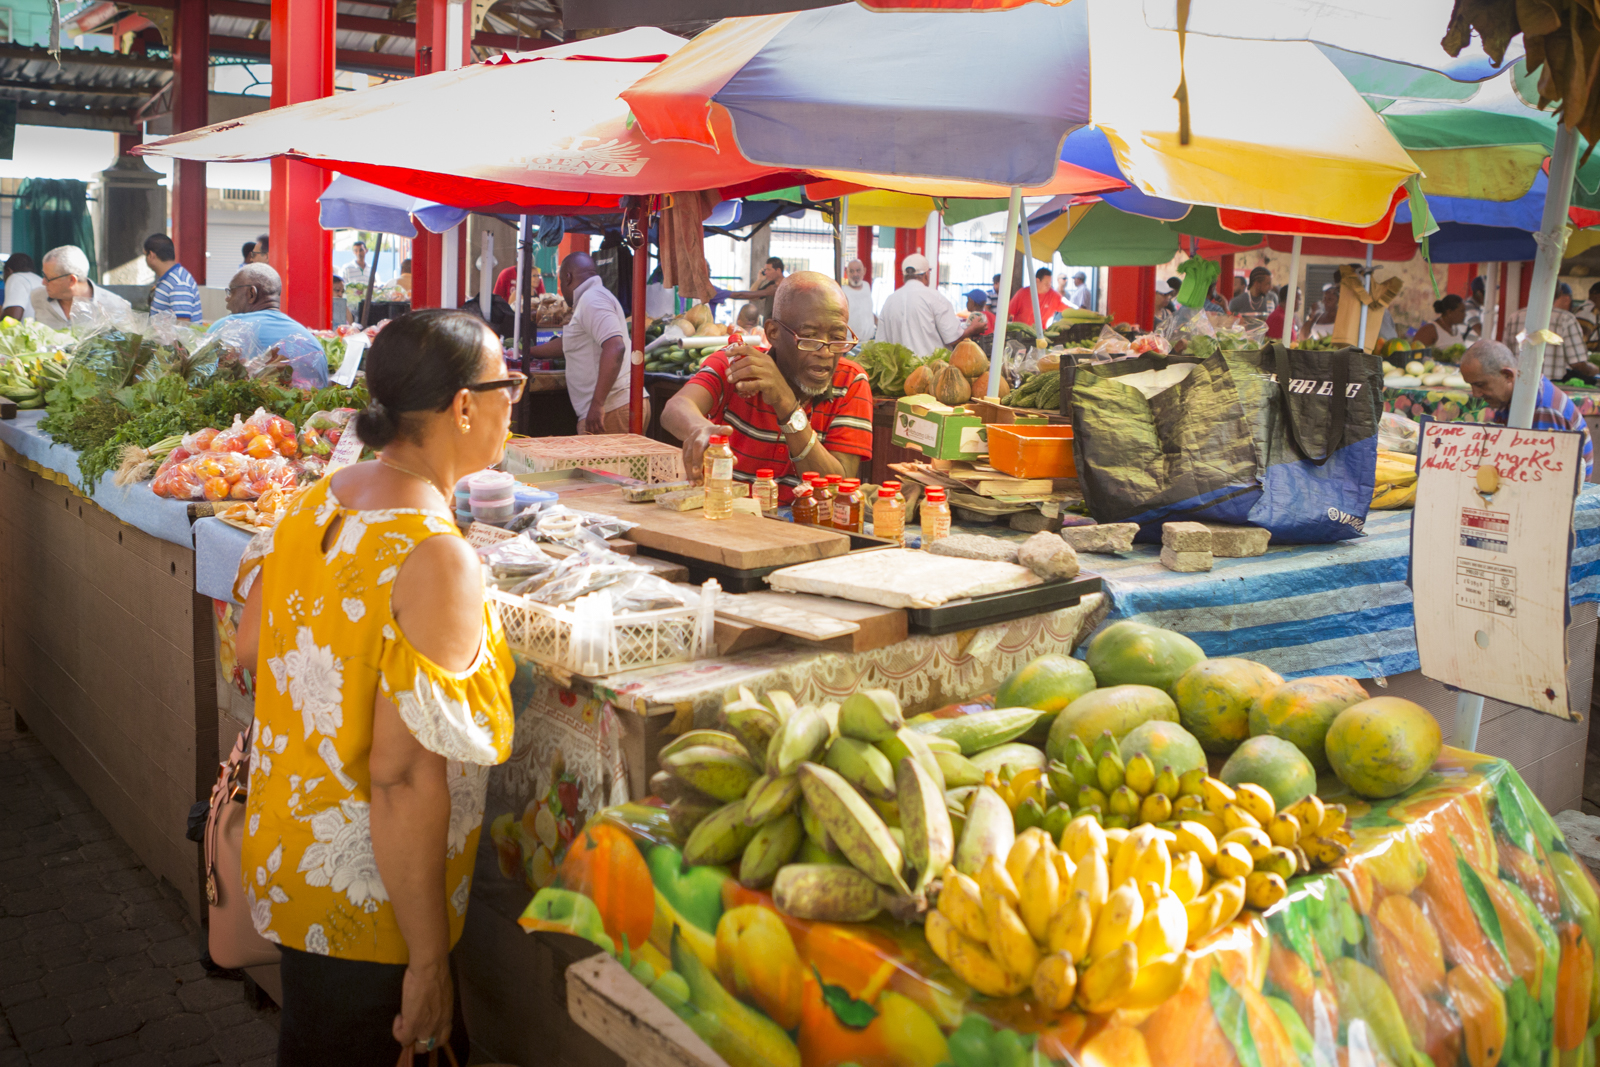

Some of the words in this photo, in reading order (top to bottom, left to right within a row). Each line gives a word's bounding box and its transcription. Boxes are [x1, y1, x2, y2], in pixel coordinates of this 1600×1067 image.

[1316, 381, 1362, 398] BG
[1426, 425, 1466, 437] Come
[1472, 429, 1502, 445] and
[1443, 442, 1458, 456] in
[1460, 442, 1492, 457] the
